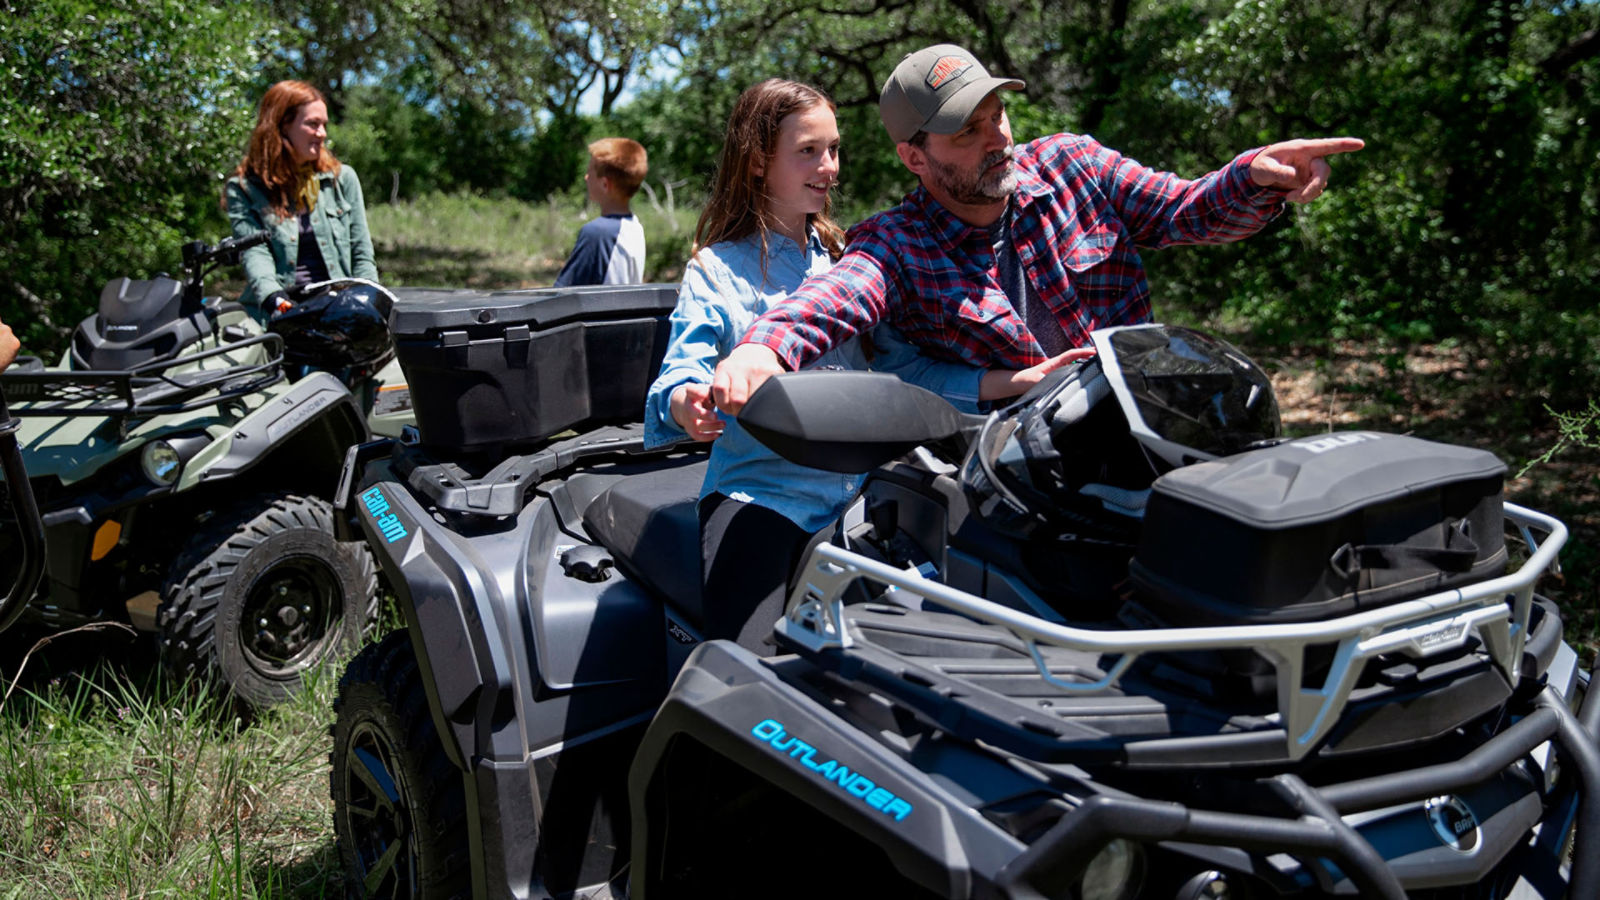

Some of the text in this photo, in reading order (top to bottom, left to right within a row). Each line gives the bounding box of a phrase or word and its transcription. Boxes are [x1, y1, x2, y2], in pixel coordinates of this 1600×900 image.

[273, 396, 327, 434] OUTLANDER
[361, 486, 408, 543] can-am
[669, 624, 693, 642] XT
[751, 718, 913, 822] OUTLANDER
